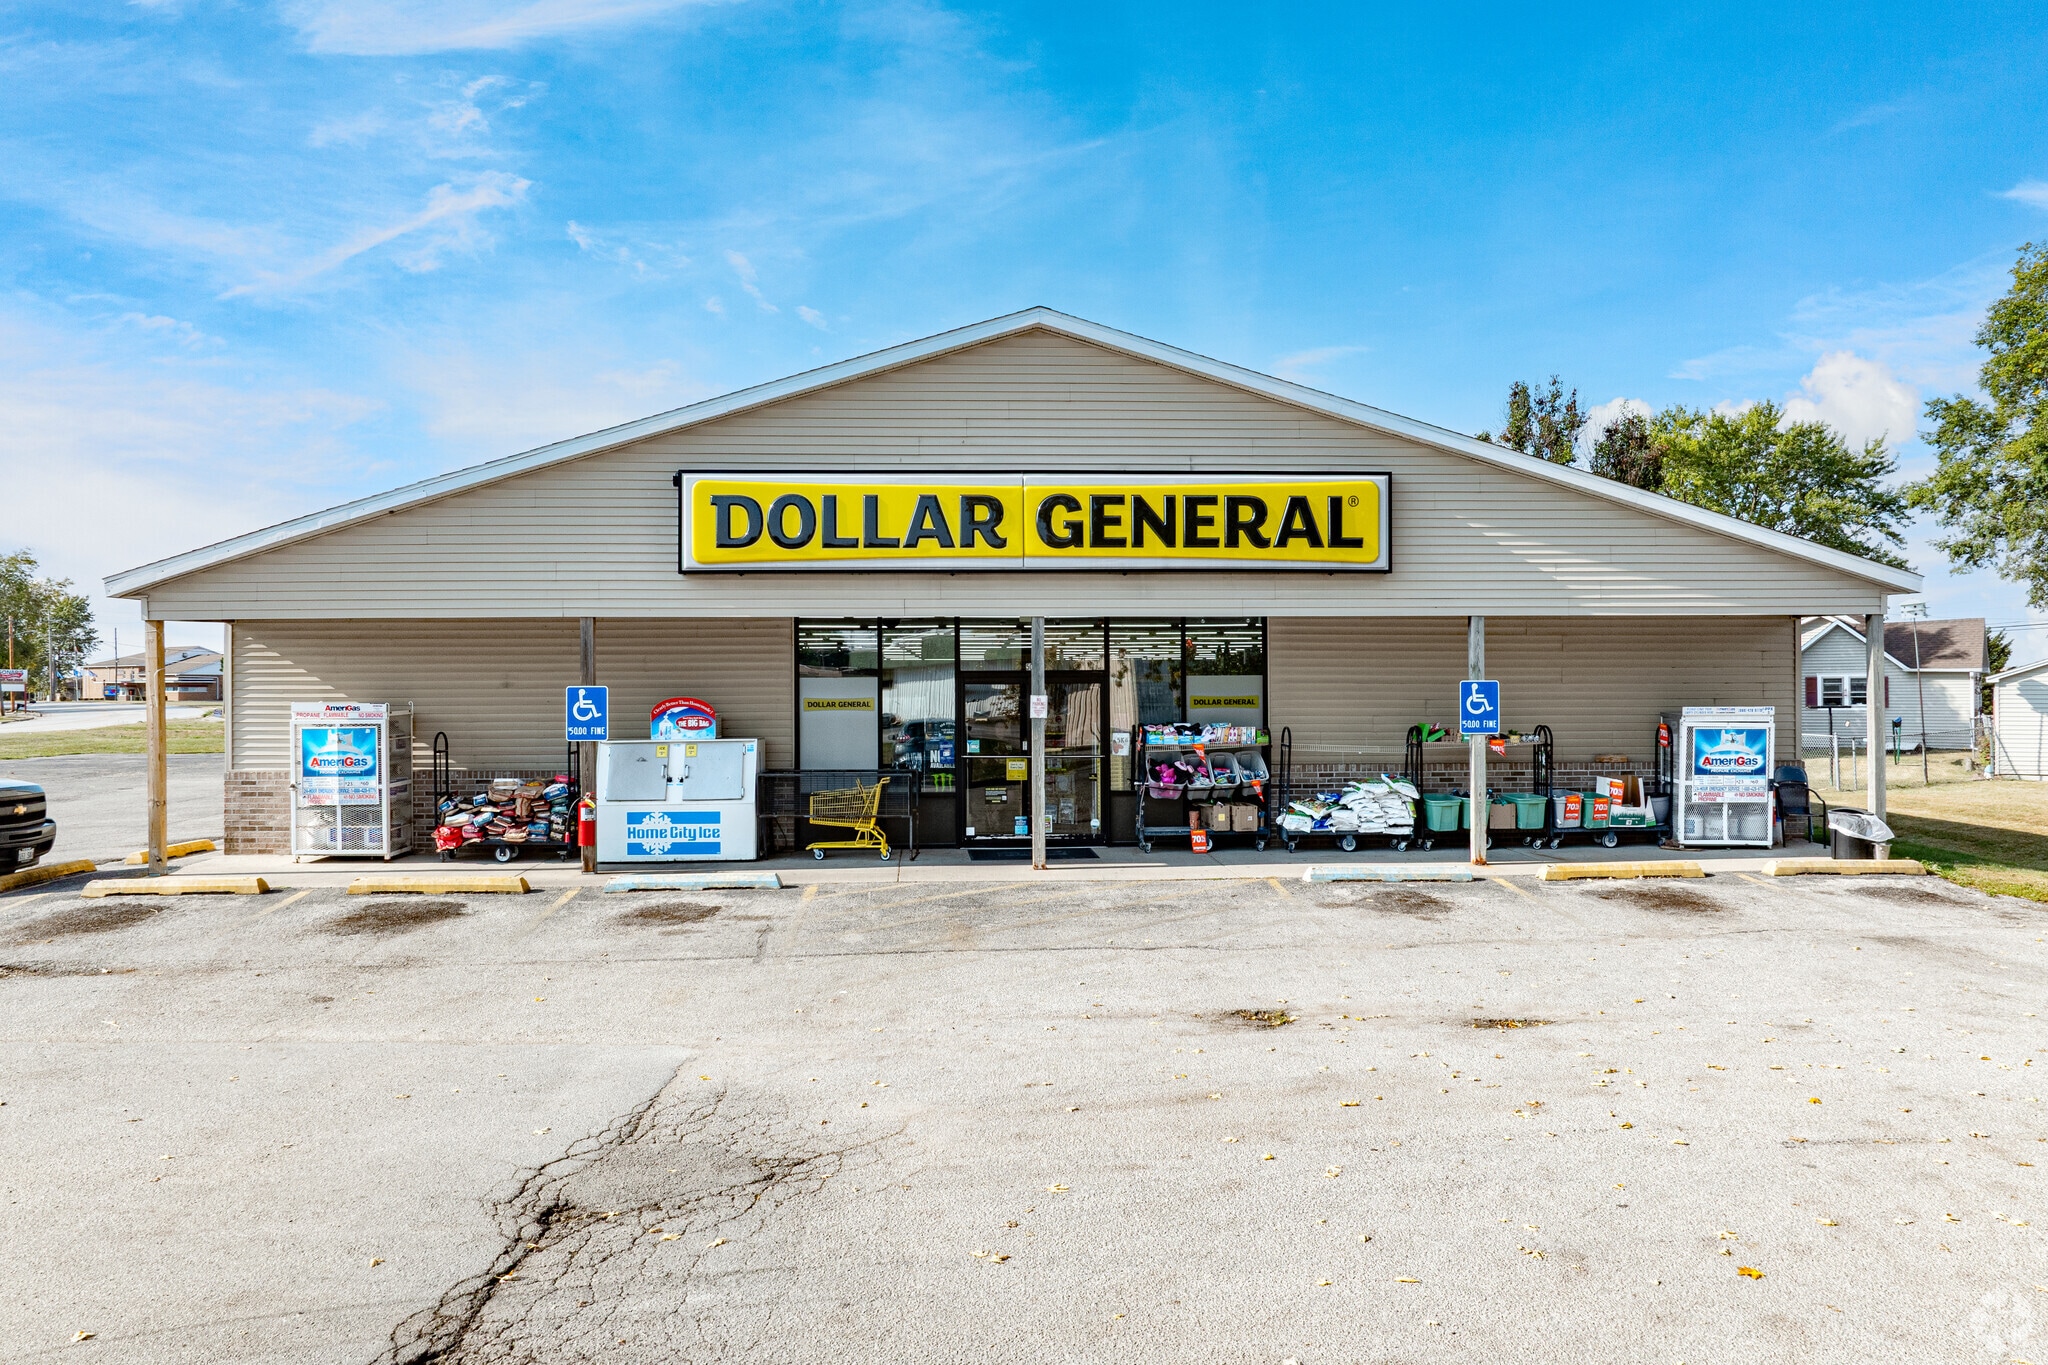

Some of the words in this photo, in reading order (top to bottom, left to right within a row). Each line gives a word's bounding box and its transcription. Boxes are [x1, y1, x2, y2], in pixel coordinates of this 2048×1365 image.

[710, 494, 1007, 549] DOLLAR
[325, 704, 361, 712] AmeriGas
[665, 700, 679, 708] Better
[1483, 720, 1497, 728] FINE
[590, 726, 606, 736] FINE
[311, 757, 368, 767] AmeriGas
[1702, 756, 1758, 766] AmeriGas
[627, 826, 667, 839] Home
[670, 826, 697, 841] City
[698, 826, 721, 839] Ice
